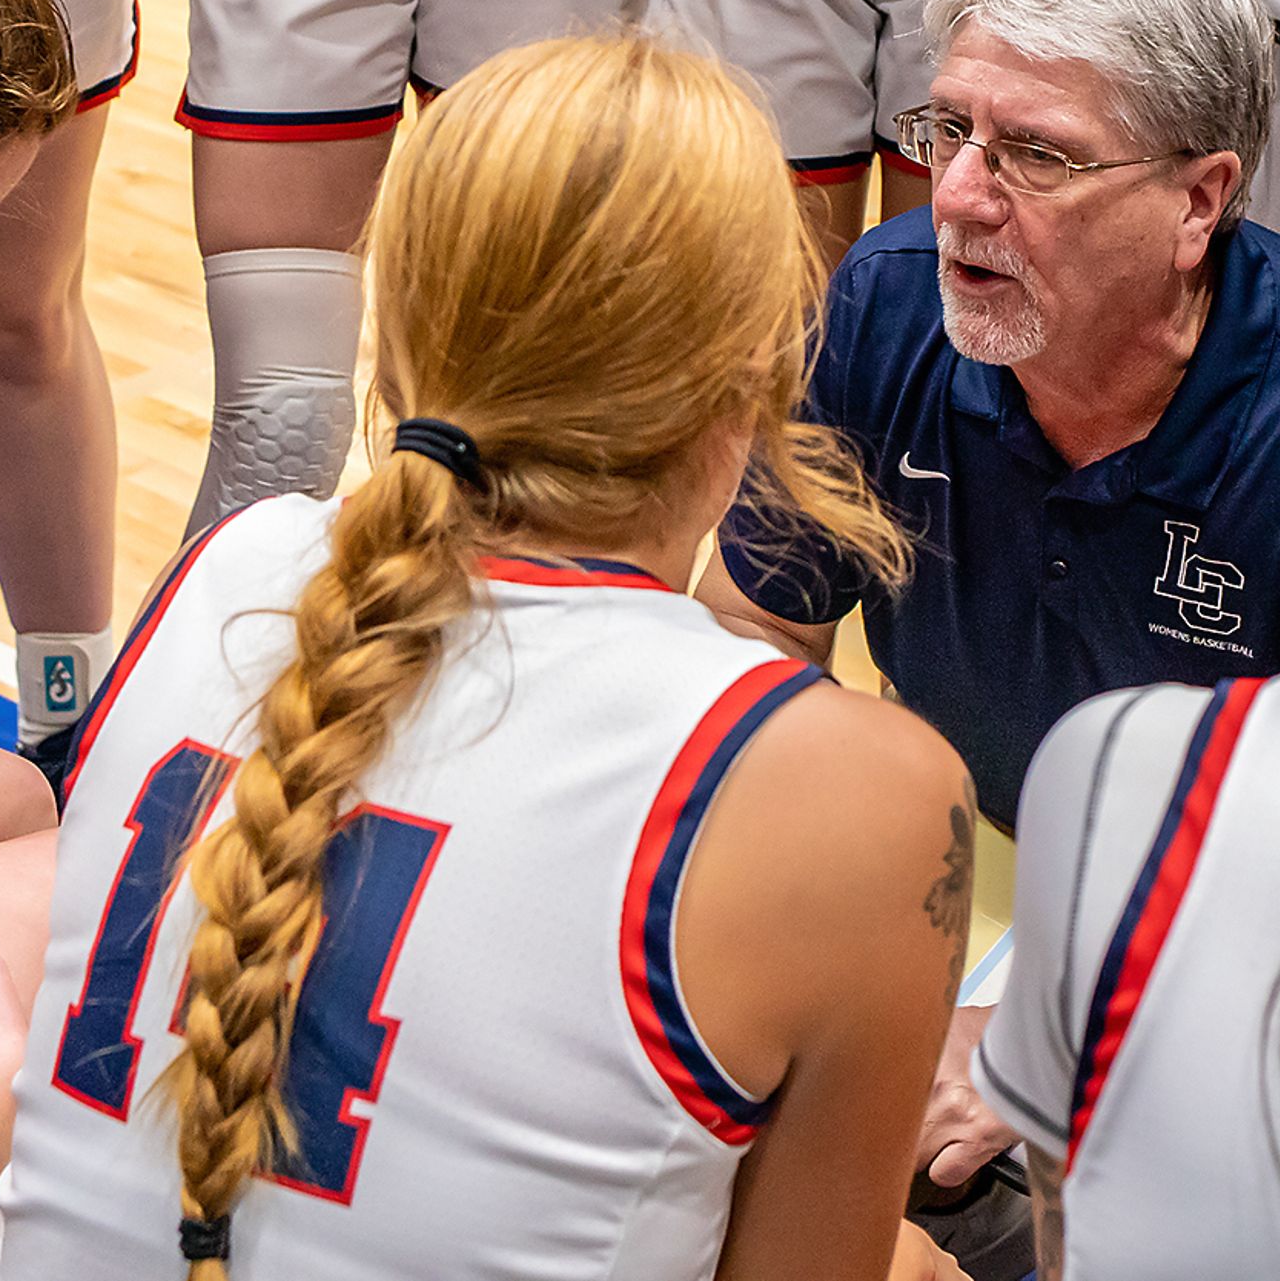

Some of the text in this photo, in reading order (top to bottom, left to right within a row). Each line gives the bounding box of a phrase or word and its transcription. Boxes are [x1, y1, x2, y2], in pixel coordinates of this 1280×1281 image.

[1153, 519, 1246, 636] LC
[1148, 622, 1255, 659] WOMENS BASKETBALL
